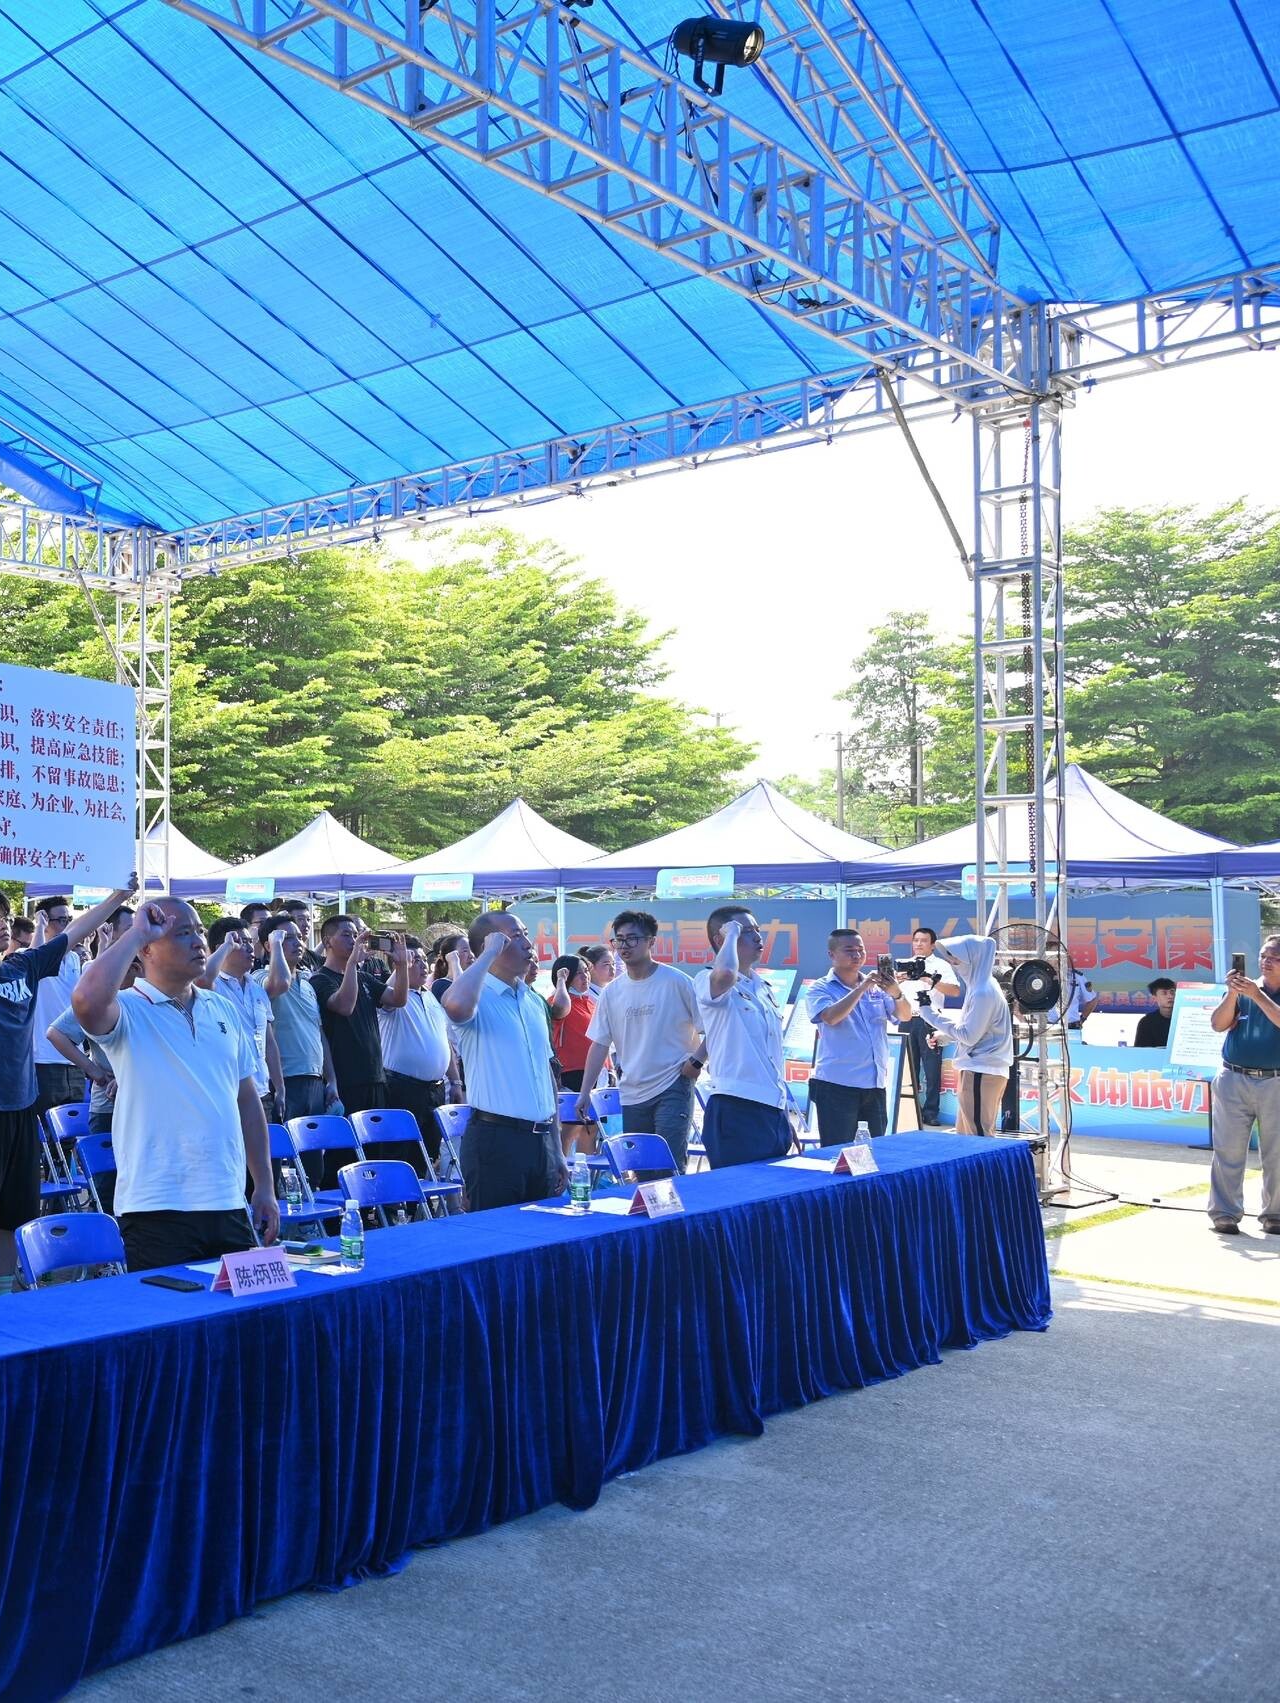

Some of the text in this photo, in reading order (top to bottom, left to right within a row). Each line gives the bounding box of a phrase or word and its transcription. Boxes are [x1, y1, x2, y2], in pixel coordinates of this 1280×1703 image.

[31, 708, 124, 741] 落实安全责任；
[31, 735, 125, 768] 提高应急技能；
[31, 764, 125, 793] 不留事故隐患；
[234, 1260, 290, 1289] 陈炳照
